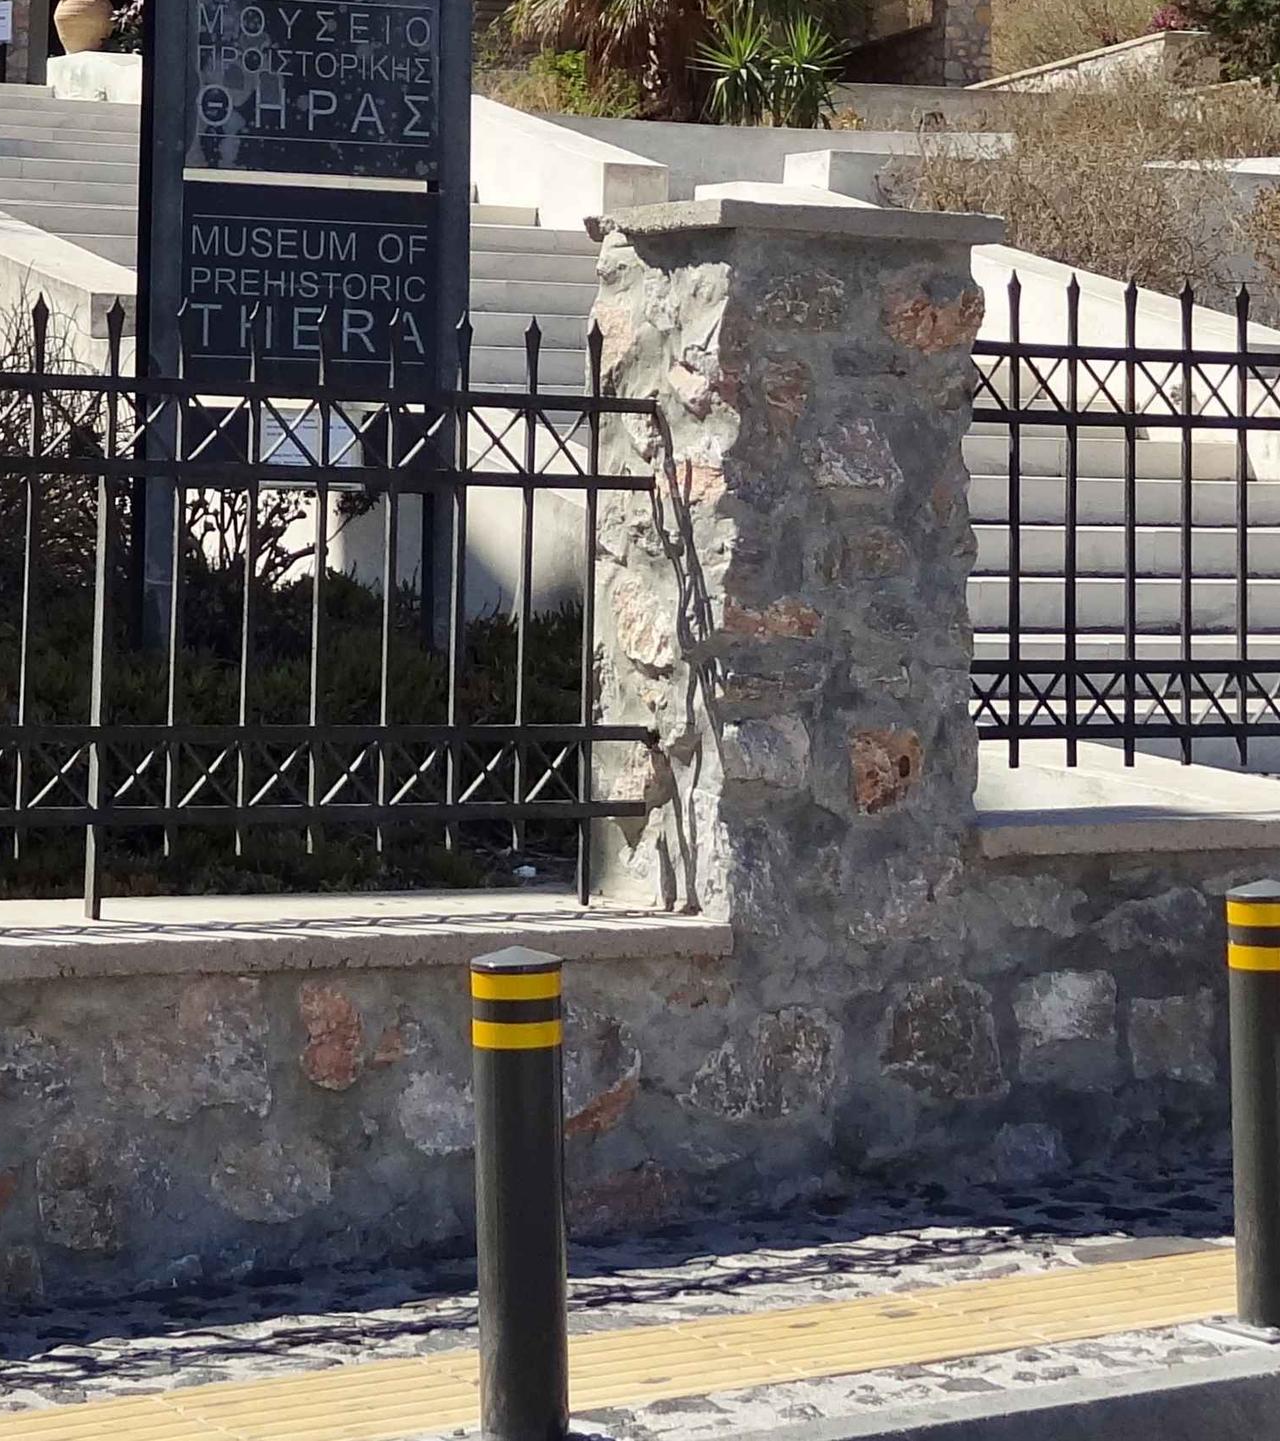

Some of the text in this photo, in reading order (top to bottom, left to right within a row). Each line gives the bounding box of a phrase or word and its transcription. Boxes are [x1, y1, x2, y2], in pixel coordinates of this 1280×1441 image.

[198, 3, 430, 47] ΜΟΥΣΕΙΟ
[197, 45, 431, 84] ΠΡΟΙΣΤΟΡΙΚΗΣ
[197, 84, 430, 137] ΘΗΡΑΣ
[191, 224, 428, 265] MUSEUM OF
[190, 266, 427, 303] PREHISTORIC
[190, 303, 425, 355] THERA
